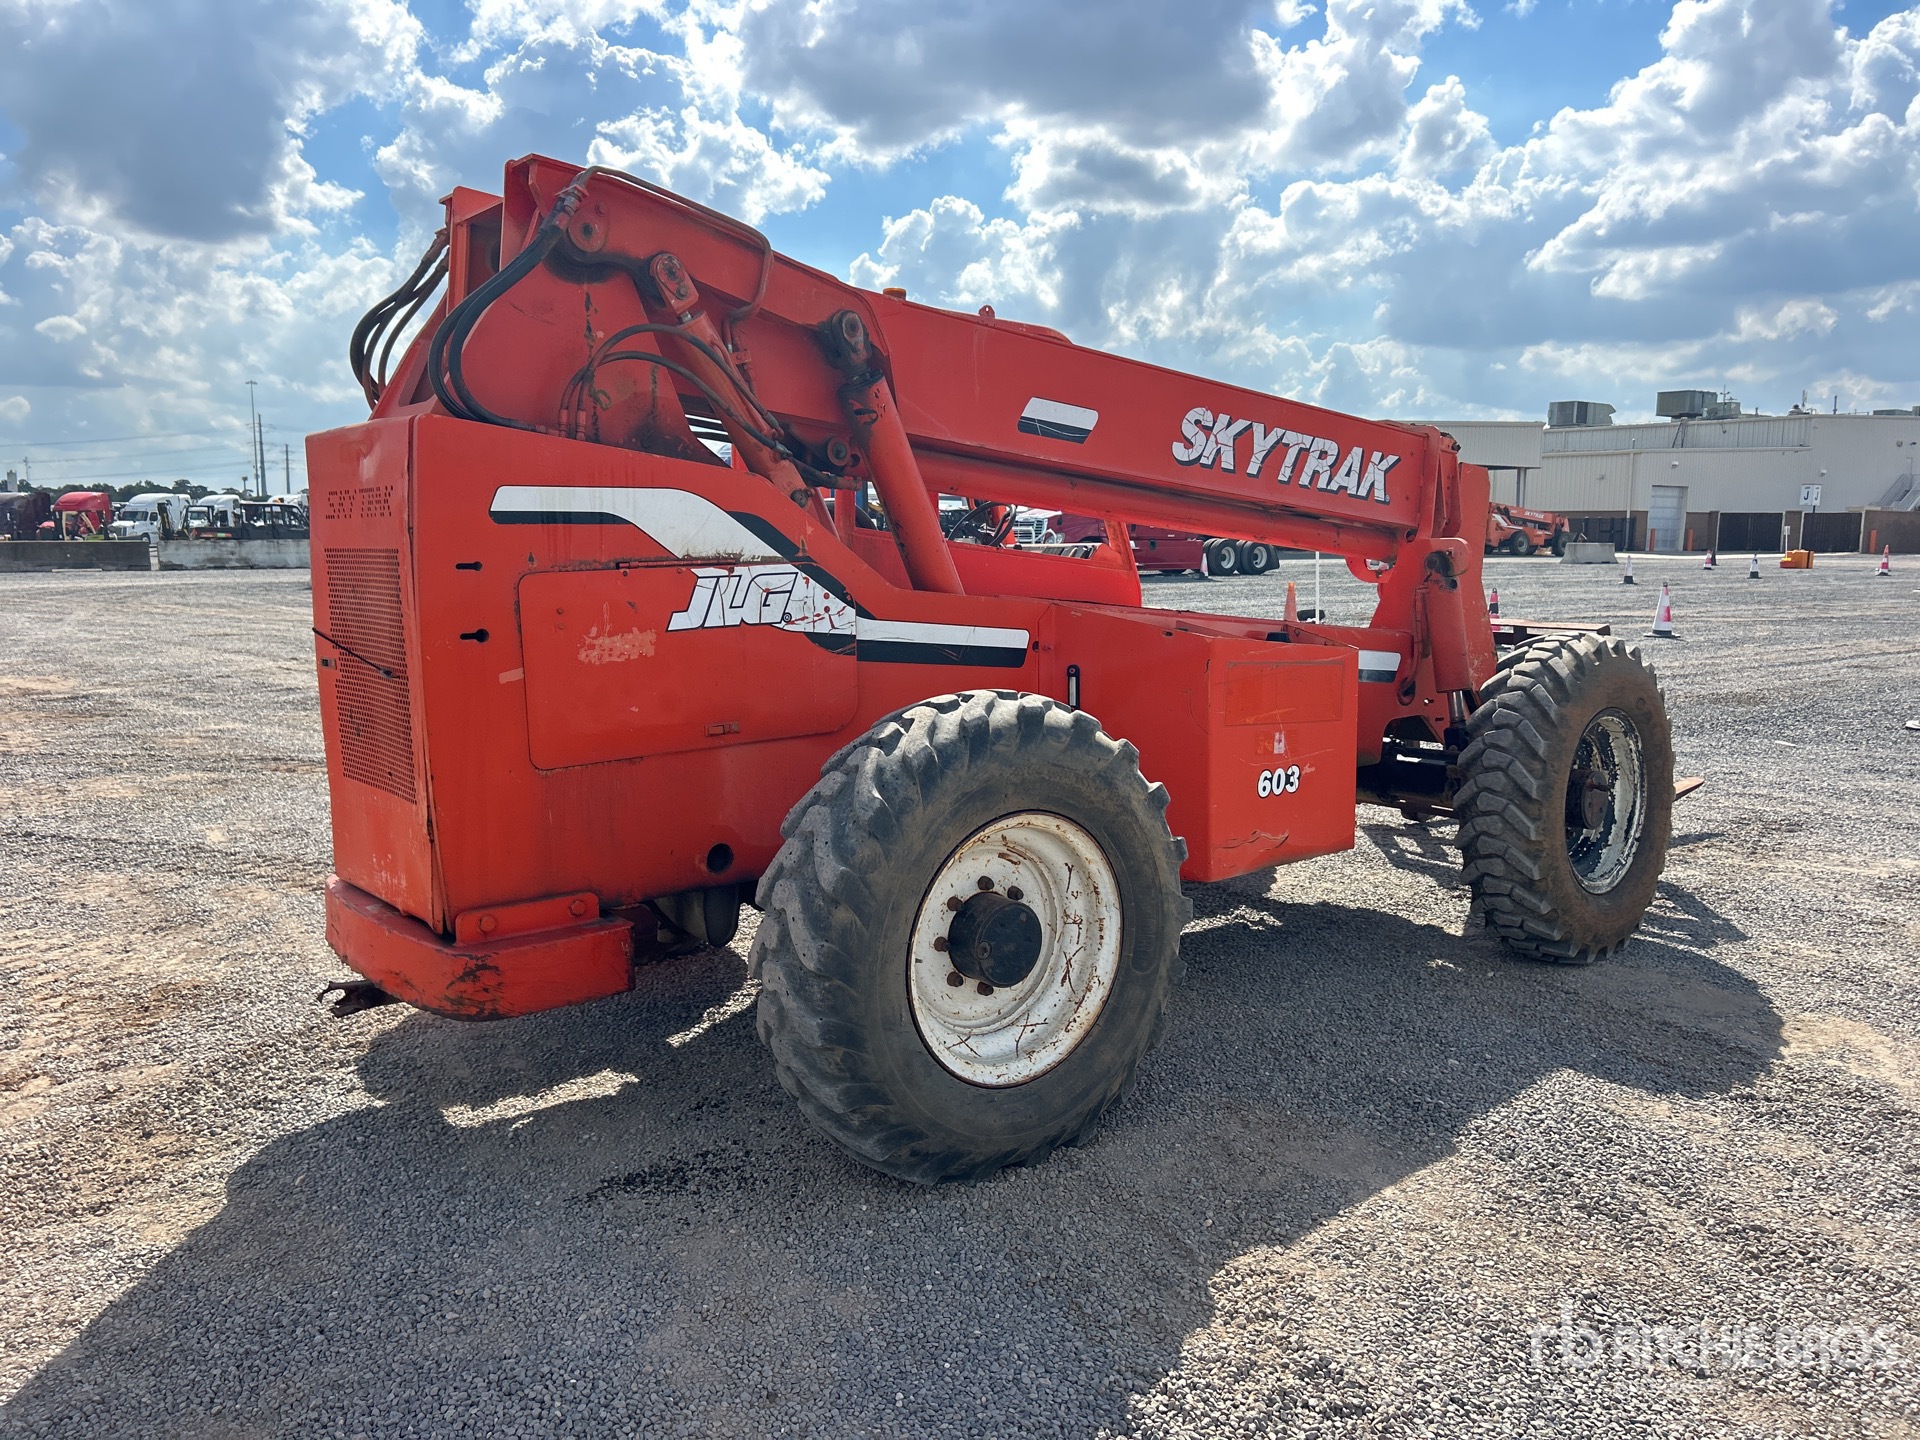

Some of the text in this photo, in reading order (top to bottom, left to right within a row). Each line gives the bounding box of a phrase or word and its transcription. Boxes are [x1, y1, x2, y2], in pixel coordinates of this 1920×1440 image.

[1172, 407, 1401, 502] SKYTRAK
[666, 571, 799, 632] JLG
[1257, 764, 1301, 798] 603
